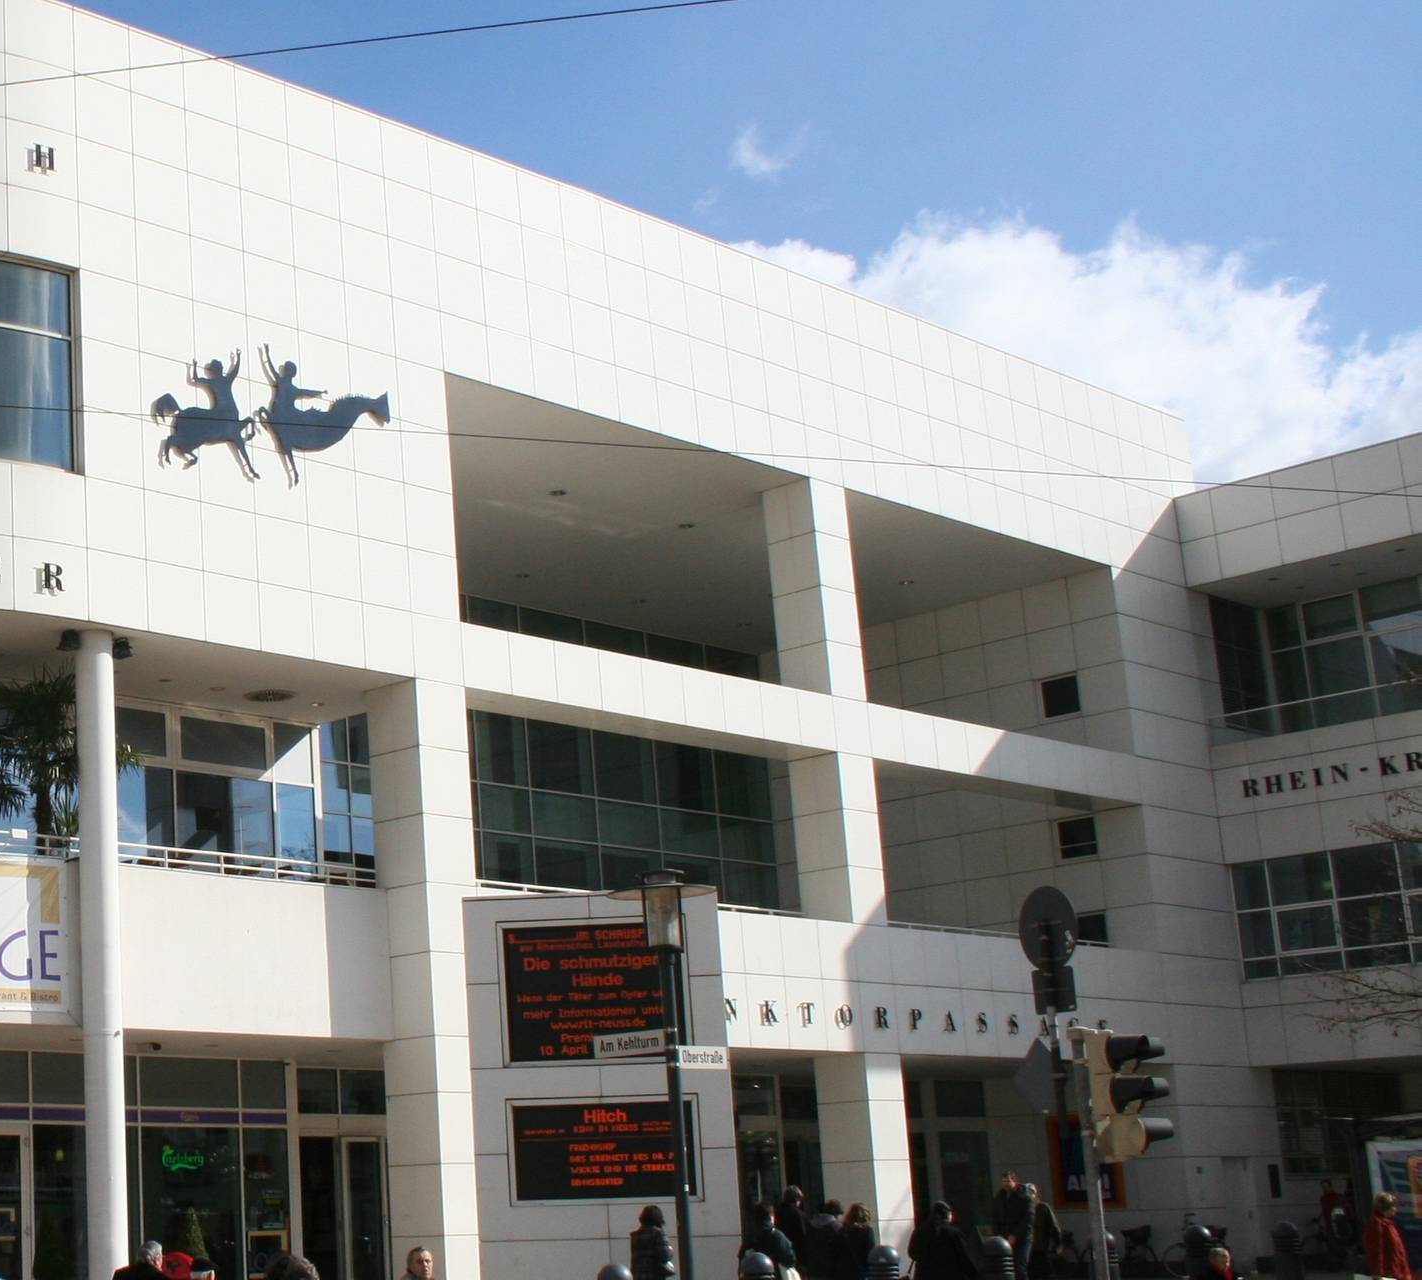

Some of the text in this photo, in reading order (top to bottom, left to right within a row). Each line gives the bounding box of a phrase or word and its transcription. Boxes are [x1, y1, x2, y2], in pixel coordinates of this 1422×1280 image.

[522, 956, 551, 972] Die
[571, 973, 624, 987] Hände
[30, 990, 59, 1002] Bistro
[522, 1010, 552, 1020] mehr
[559, 1006, 636, 1018] Informationen
[561, 1044, 590, 1056] April
[600, 1035, 660, 1053] Am Kehlturm
[682, 1051, 724, 1065] Oberstraße
[583, 1109, 627, 1124] Hitch
[162, 1145, 204, 1171] Carlsberg
